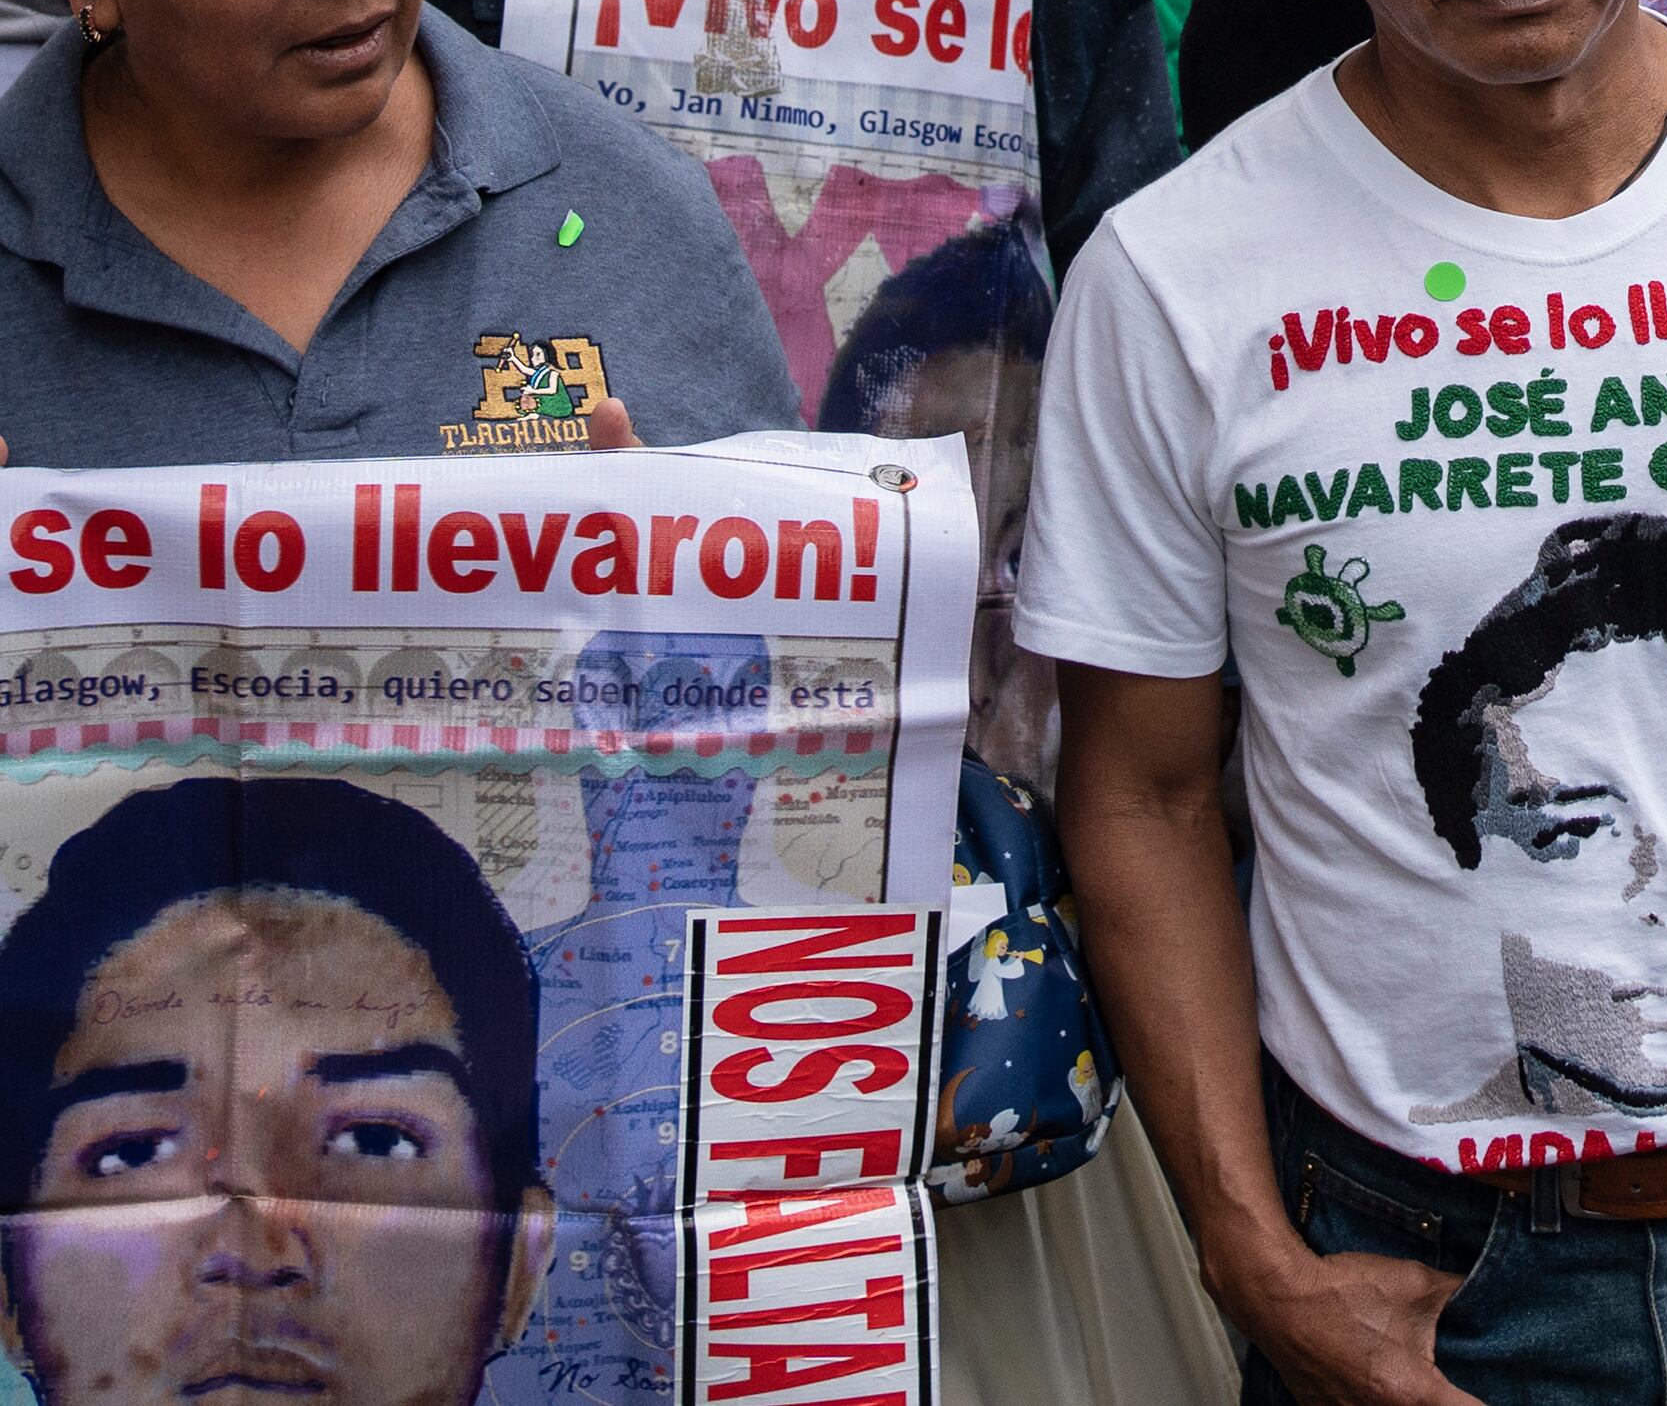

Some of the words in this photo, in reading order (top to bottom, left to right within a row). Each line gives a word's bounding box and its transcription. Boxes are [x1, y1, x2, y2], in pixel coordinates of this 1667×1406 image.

[670, 87, 722, 116] Jan
[740, 95, 837, 135] Nimmo,
[859, 109, 962, 146] Glasgow
[1268, 305, 1440, 392] ¡Vivo
[1455, 304, 1532, 357] se
[1545, 291, 1617, 351] lo
[1394, 367, 1573, 442] JOSÉ
[1234, 445, 1628, 530] NAVARRETE
[8, 508, 153, 594] se
[199, 483, 306, 593] lo
[352, 483, 880, 602] llevaron!
[190, 666, 354, 704] Escocia,
[384, 669, 513, 707] quiero
[662, 673, 770, 710] dónde
[789, 677, 876, 711] está
[665, 939, 681, 963] 7
[708, 911, 917, 1104] NOS
[659, 1029, 678, 1055] 8
[657, 1121, 677, 1146] 9
[568, 1249, 592, 1273] 9
[707, 1128, 908, 1406] FALTA
